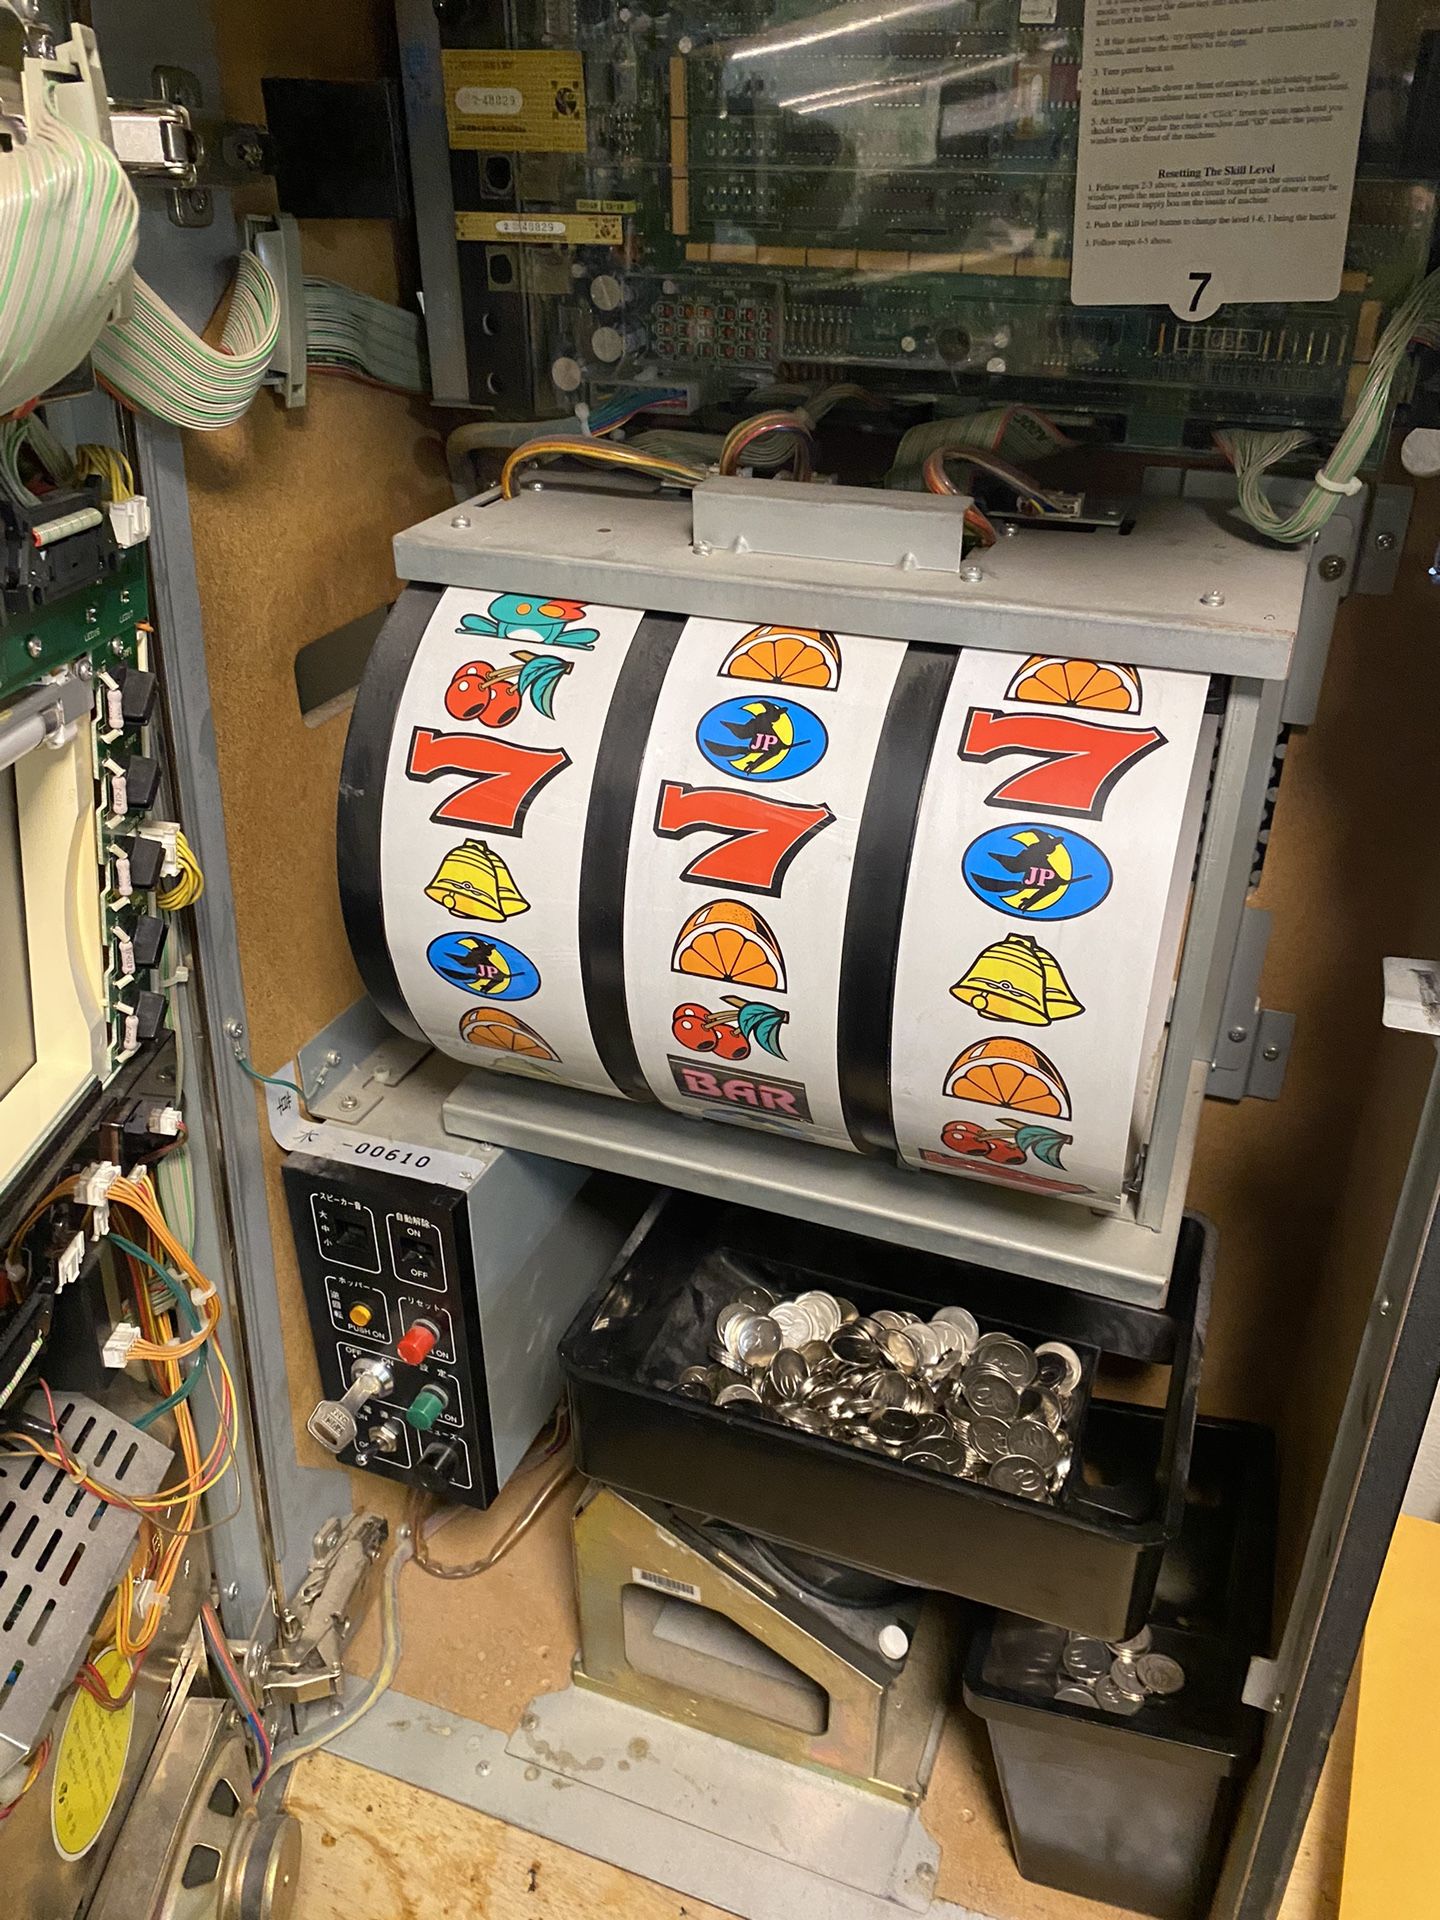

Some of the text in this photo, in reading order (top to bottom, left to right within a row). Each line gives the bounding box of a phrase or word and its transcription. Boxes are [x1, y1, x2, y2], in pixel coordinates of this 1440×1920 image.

[1158, 164, 1275, 179] Resetting The Skill Level
[1188, 272, 1212, 312] 7
[751, 733, 779, 751] JP
[957, 706, 1169, 821] 7
[405, 725, 573, 838] 7
[653, 779, 837, 898] 7
[1024, 866, 1055, 887] JP
[477, 964, 499, 979] JP
[681, 1068, 800, 1115] BAR
[319, 1210, 328, 1220] 大
[407, 1228, 421, 1237] ON
[324, 1238, 332, 1247] 小
[410, 1268, 429, 1278] OFF
[338, 1277, 370, 1289] ホッパー
[408, 1296, 440, 1312] リセット
[348, 1323, 386, 1340] PUSH ON
[345, 1346, 361, 1356] OFF
[436, 1350, 449, 1359] ON
[444, 1414, 457, 1423] ON
